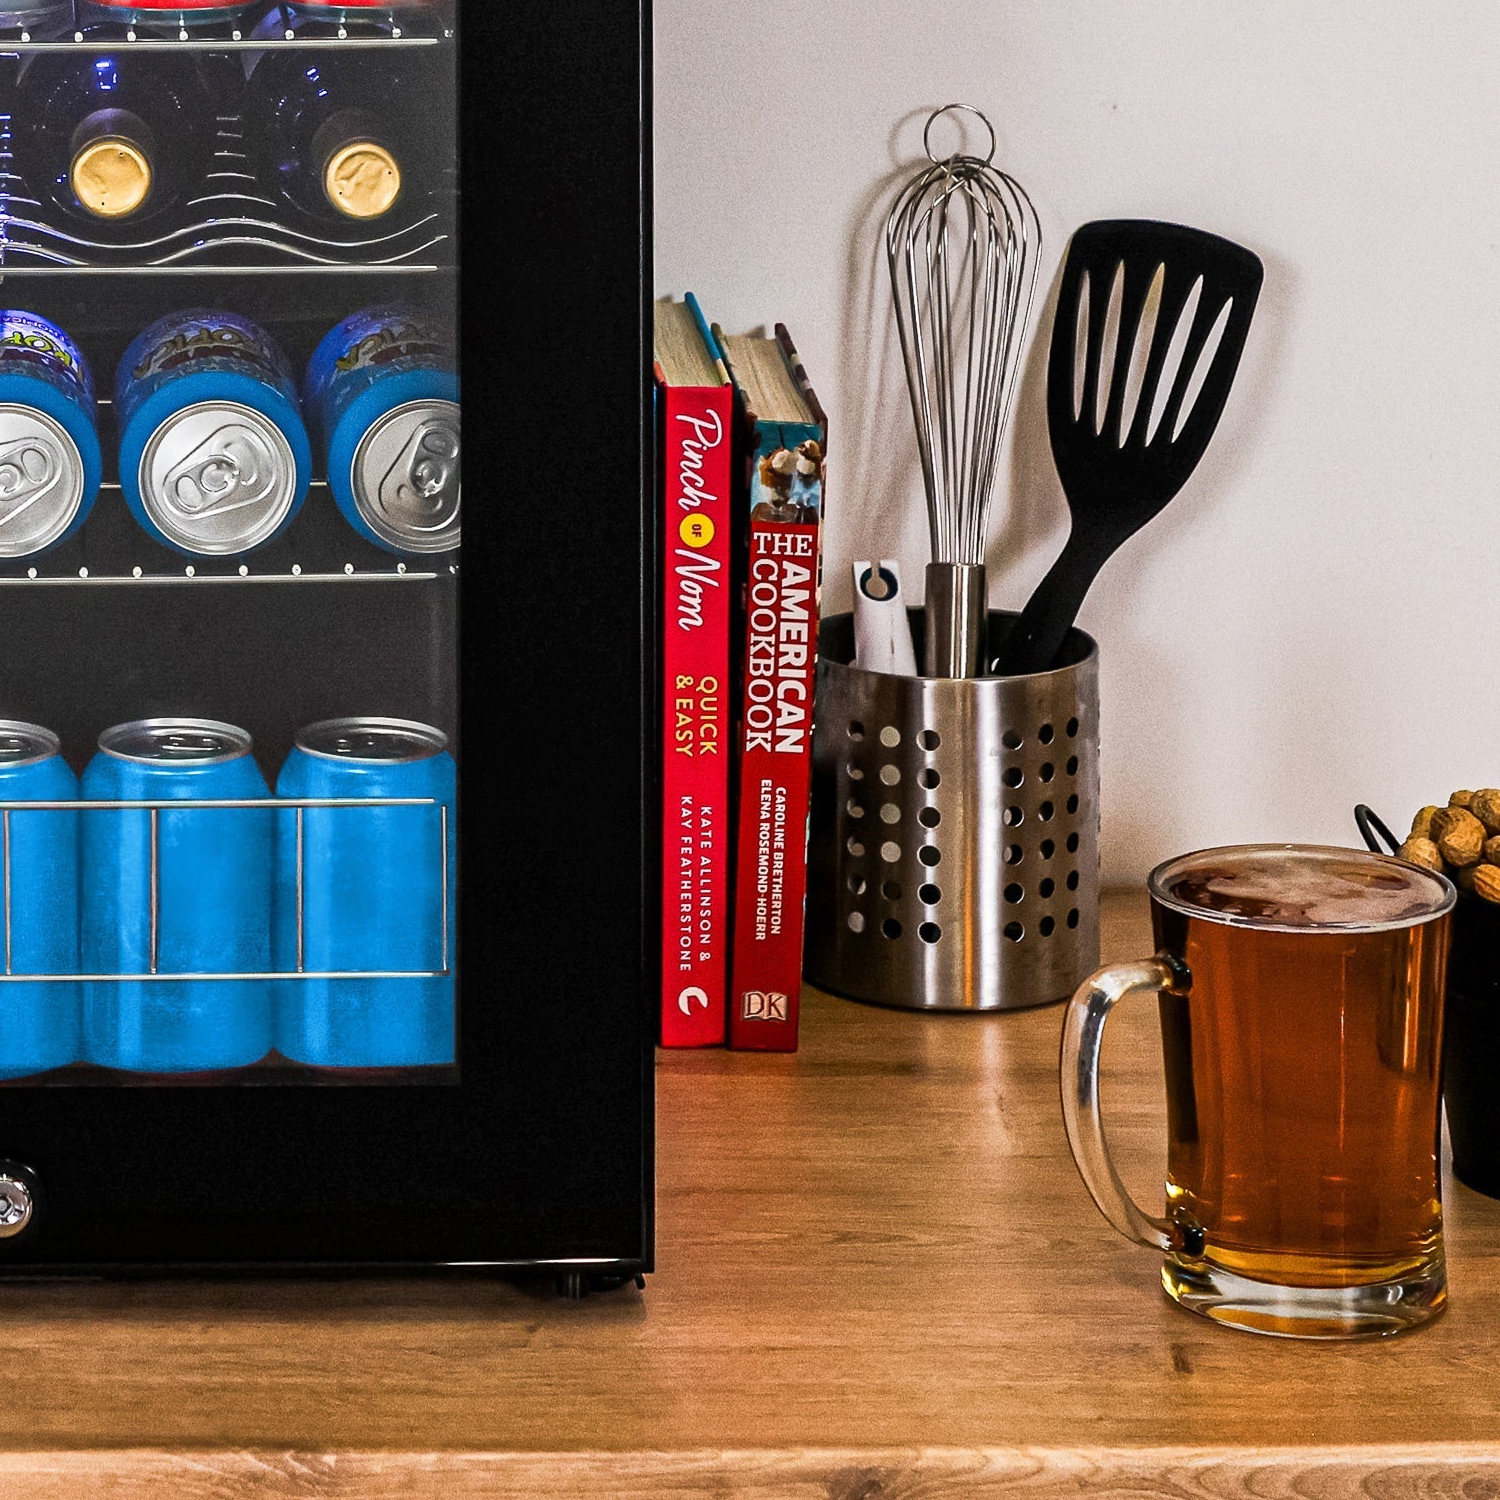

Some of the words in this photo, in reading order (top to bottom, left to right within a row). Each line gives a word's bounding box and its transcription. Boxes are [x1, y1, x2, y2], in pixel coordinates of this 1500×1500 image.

[675, 408, 723, 511] Pinch
[691, 523, 702, 538] OF
[754, 531, 813, 557] THE
[675, 548, 721, 632] Nom
[676, 675, 694, 689] &
[746, 558, 779, 753] COOKBOOK
[774, 560, 811, 753] AMERICAN
[675, 698, 694, 757] EASY
[695, 676, 718, 755] QUICK
[681, 796, 692, 829] KAY
[700, 806, 712, 849] KATE
[760, 779, 772, 820] ELENA
[773, 787, 786, 850] CAROLINE
[680, 836, 692, 971] FEATHERSTONE
[700, 856, 712, 944] ALLINSON
[755, 822, 771, 941] ROSEMOND-HOERR
[770, 852, 784, 935] BRETHERTON
[699, 951, 711, 961] &
[746, 992, 786, 1019] DK
